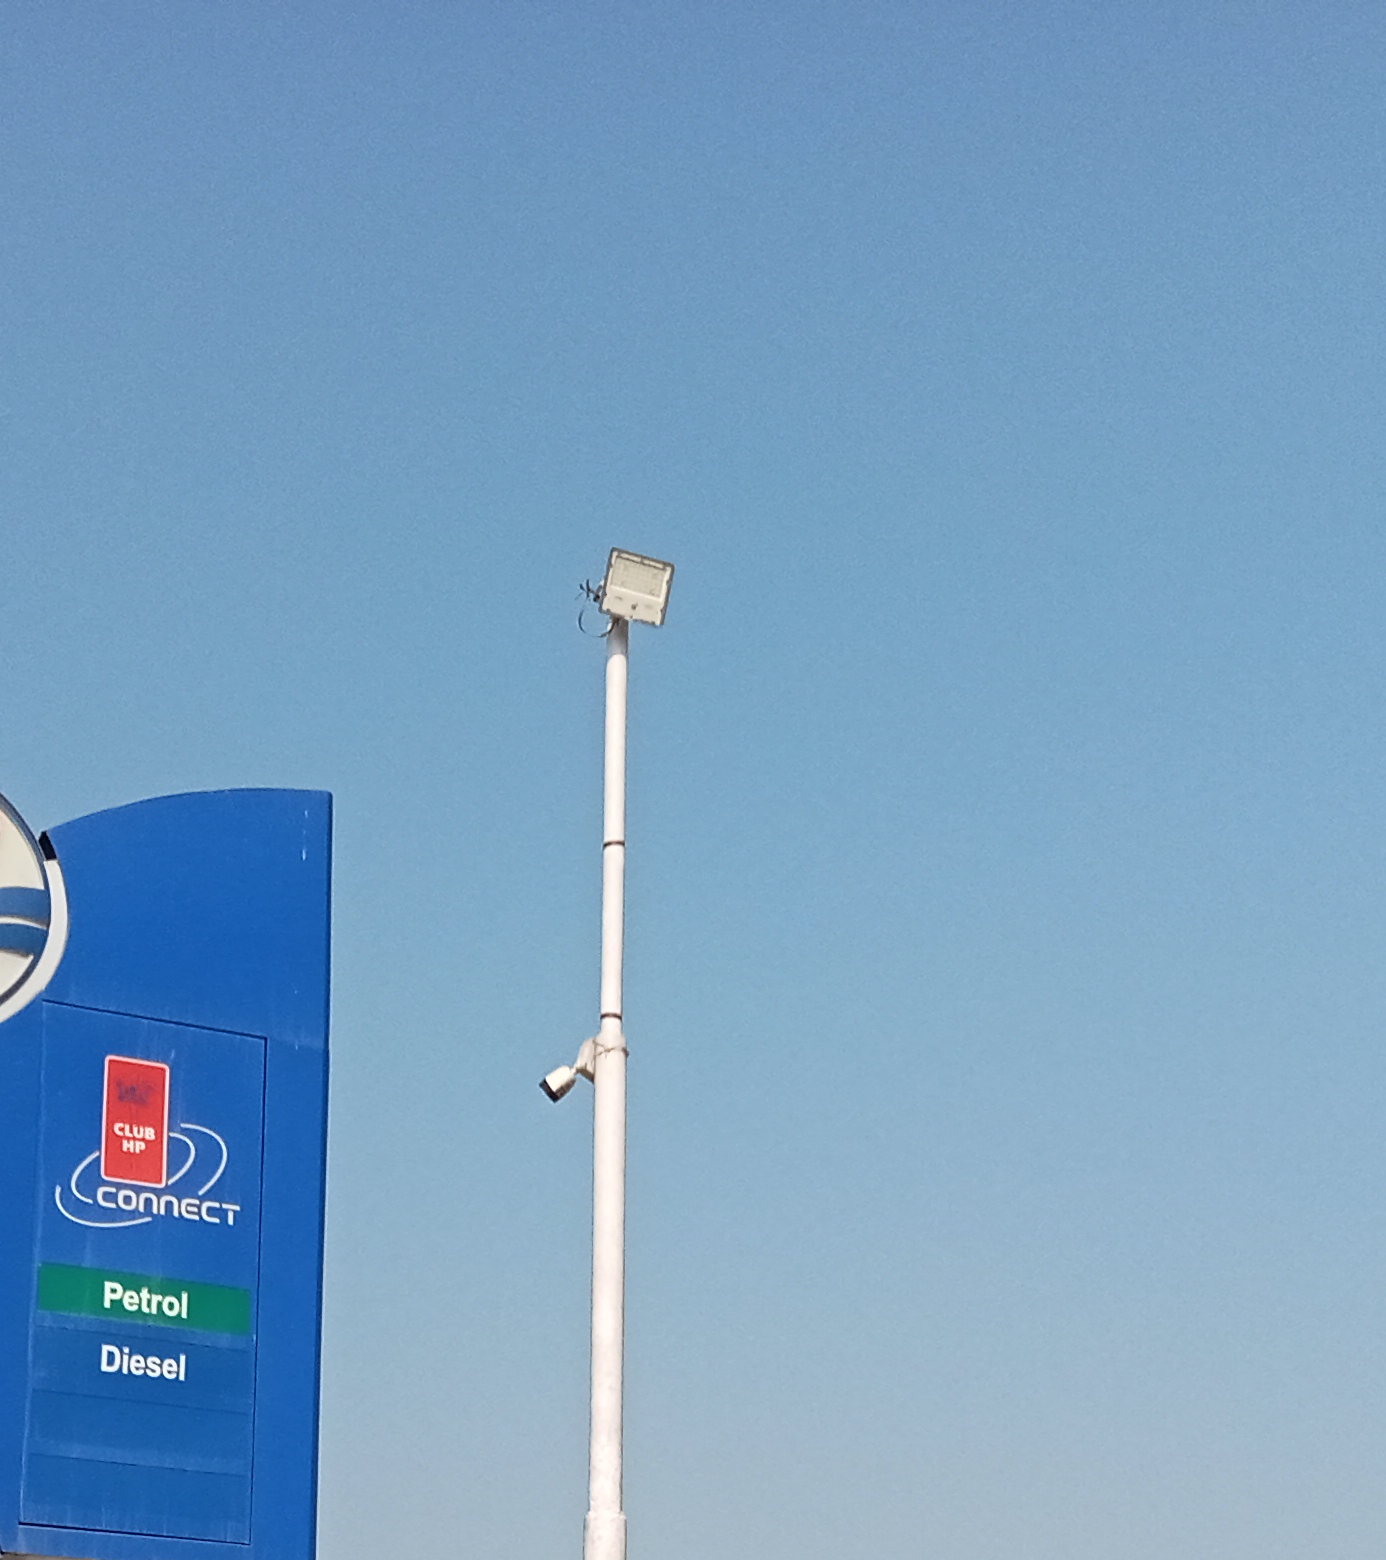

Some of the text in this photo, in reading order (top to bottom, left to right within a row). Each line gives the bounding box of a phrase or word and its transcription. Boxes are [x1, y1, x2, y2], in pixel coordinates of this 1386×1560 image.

[113, 1122, 156, 1141] CLUB
[121, 1139, 146, 1154] HP
[96, 1186, 241, 1226] CONNECT
[103, 1280, 189, 1319] Petrol
[100, 1343, 187, 1382] Diesel
